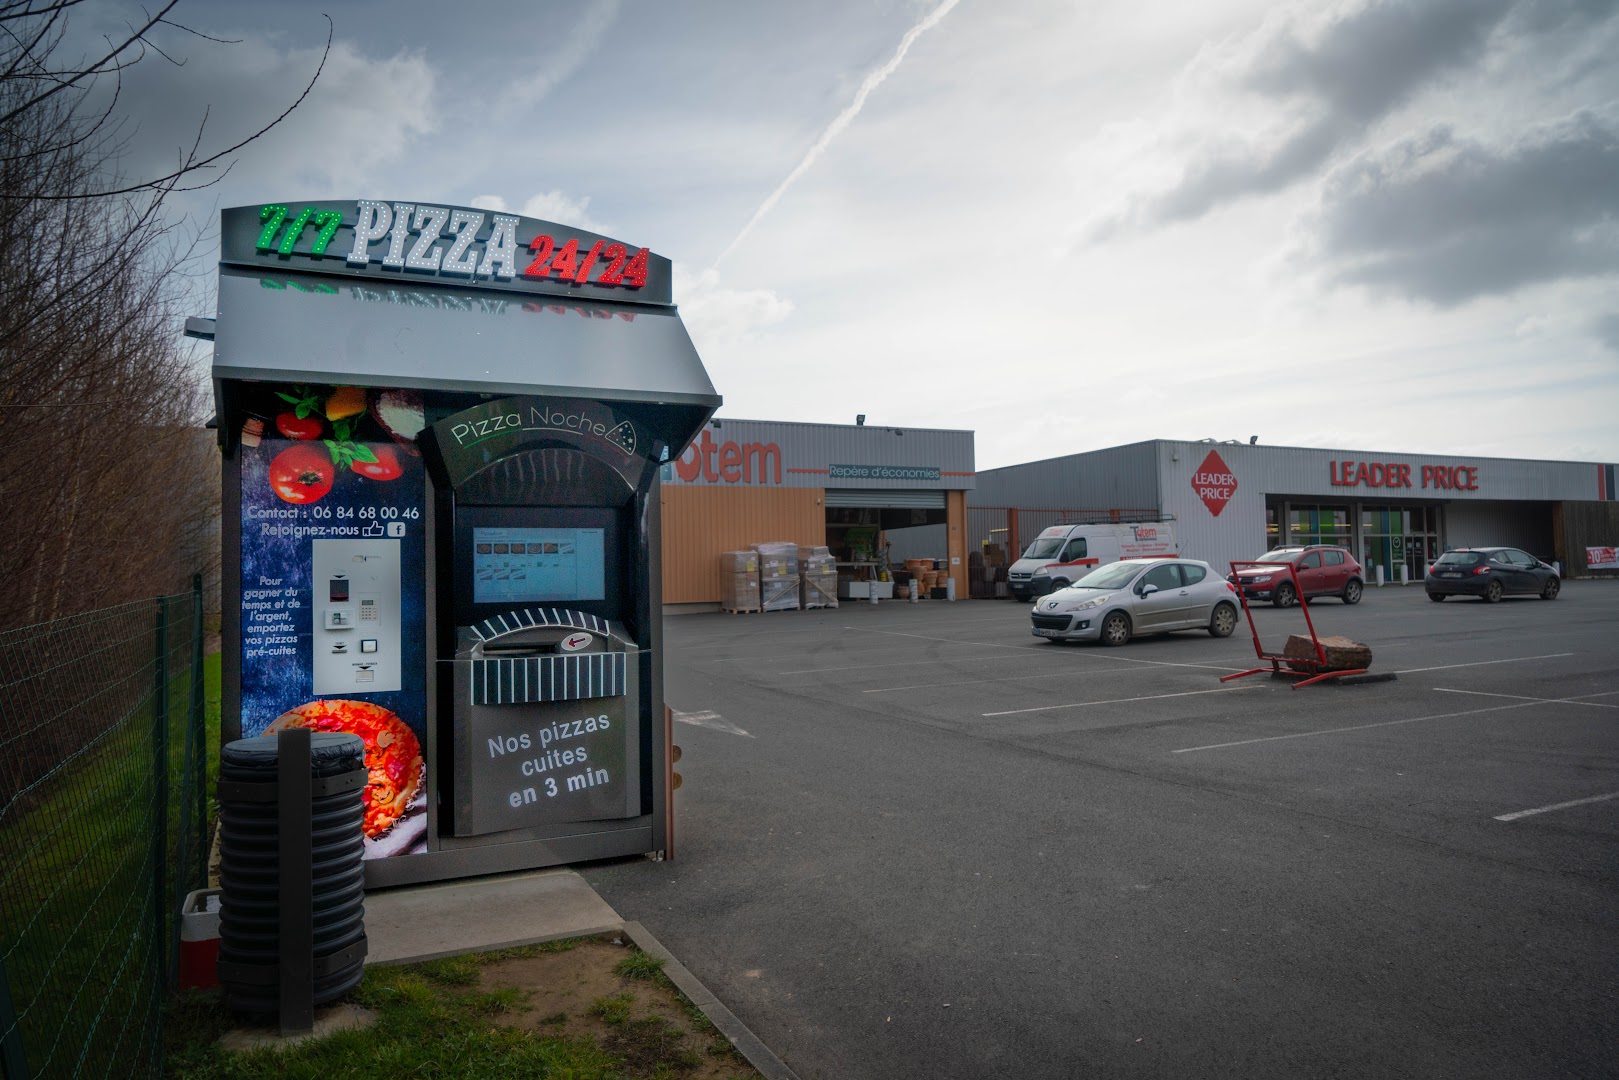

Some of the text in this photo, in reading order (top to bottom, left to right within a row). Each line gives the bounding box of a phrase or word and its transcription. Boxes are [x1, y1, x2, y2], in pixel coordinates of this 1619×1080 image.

[256, 198, 650, 287] 7/7 PIZZA 24/24
[451, 406, 606, 445] Pizza Noche
[674, 429, 782, 484] otem
[829, 465, 940, 479] Repère d'économies
[1195, 472, 1235, 486] LEADER
[1330, 460, 1479, 490] LEADER PRICE
[1200, 487, 1230, 500] PRICE
[246, 505, 300, 519] Contact
[313, 506, 332, 519] 06
[336, 506, 354, 519] 84
[358, 506, 376, 519] 68
[380, 506, 398, 519] 00
[402, 506, 420, 519] 46
[261, 522, 360, 539] Rejoignez-nous
[1129, 526, 1157, 541] Totem
[260, 575, 283, 586] Pour
[243, 586, 298, 600] gagner du
[241, 597, 301, 611] temps et de
[249, 609, 292, 623] l'argent,
[247, 622, 296, 635] emportez
[244, 634, 298, 647] vos pizzas
[246, 645, 297, 659] pré-cuites
[487, 713, 611, 758] Nos pizzas
[521, 745, 588, 778] cuites
[509, 766, 610, 808] en 3 min
